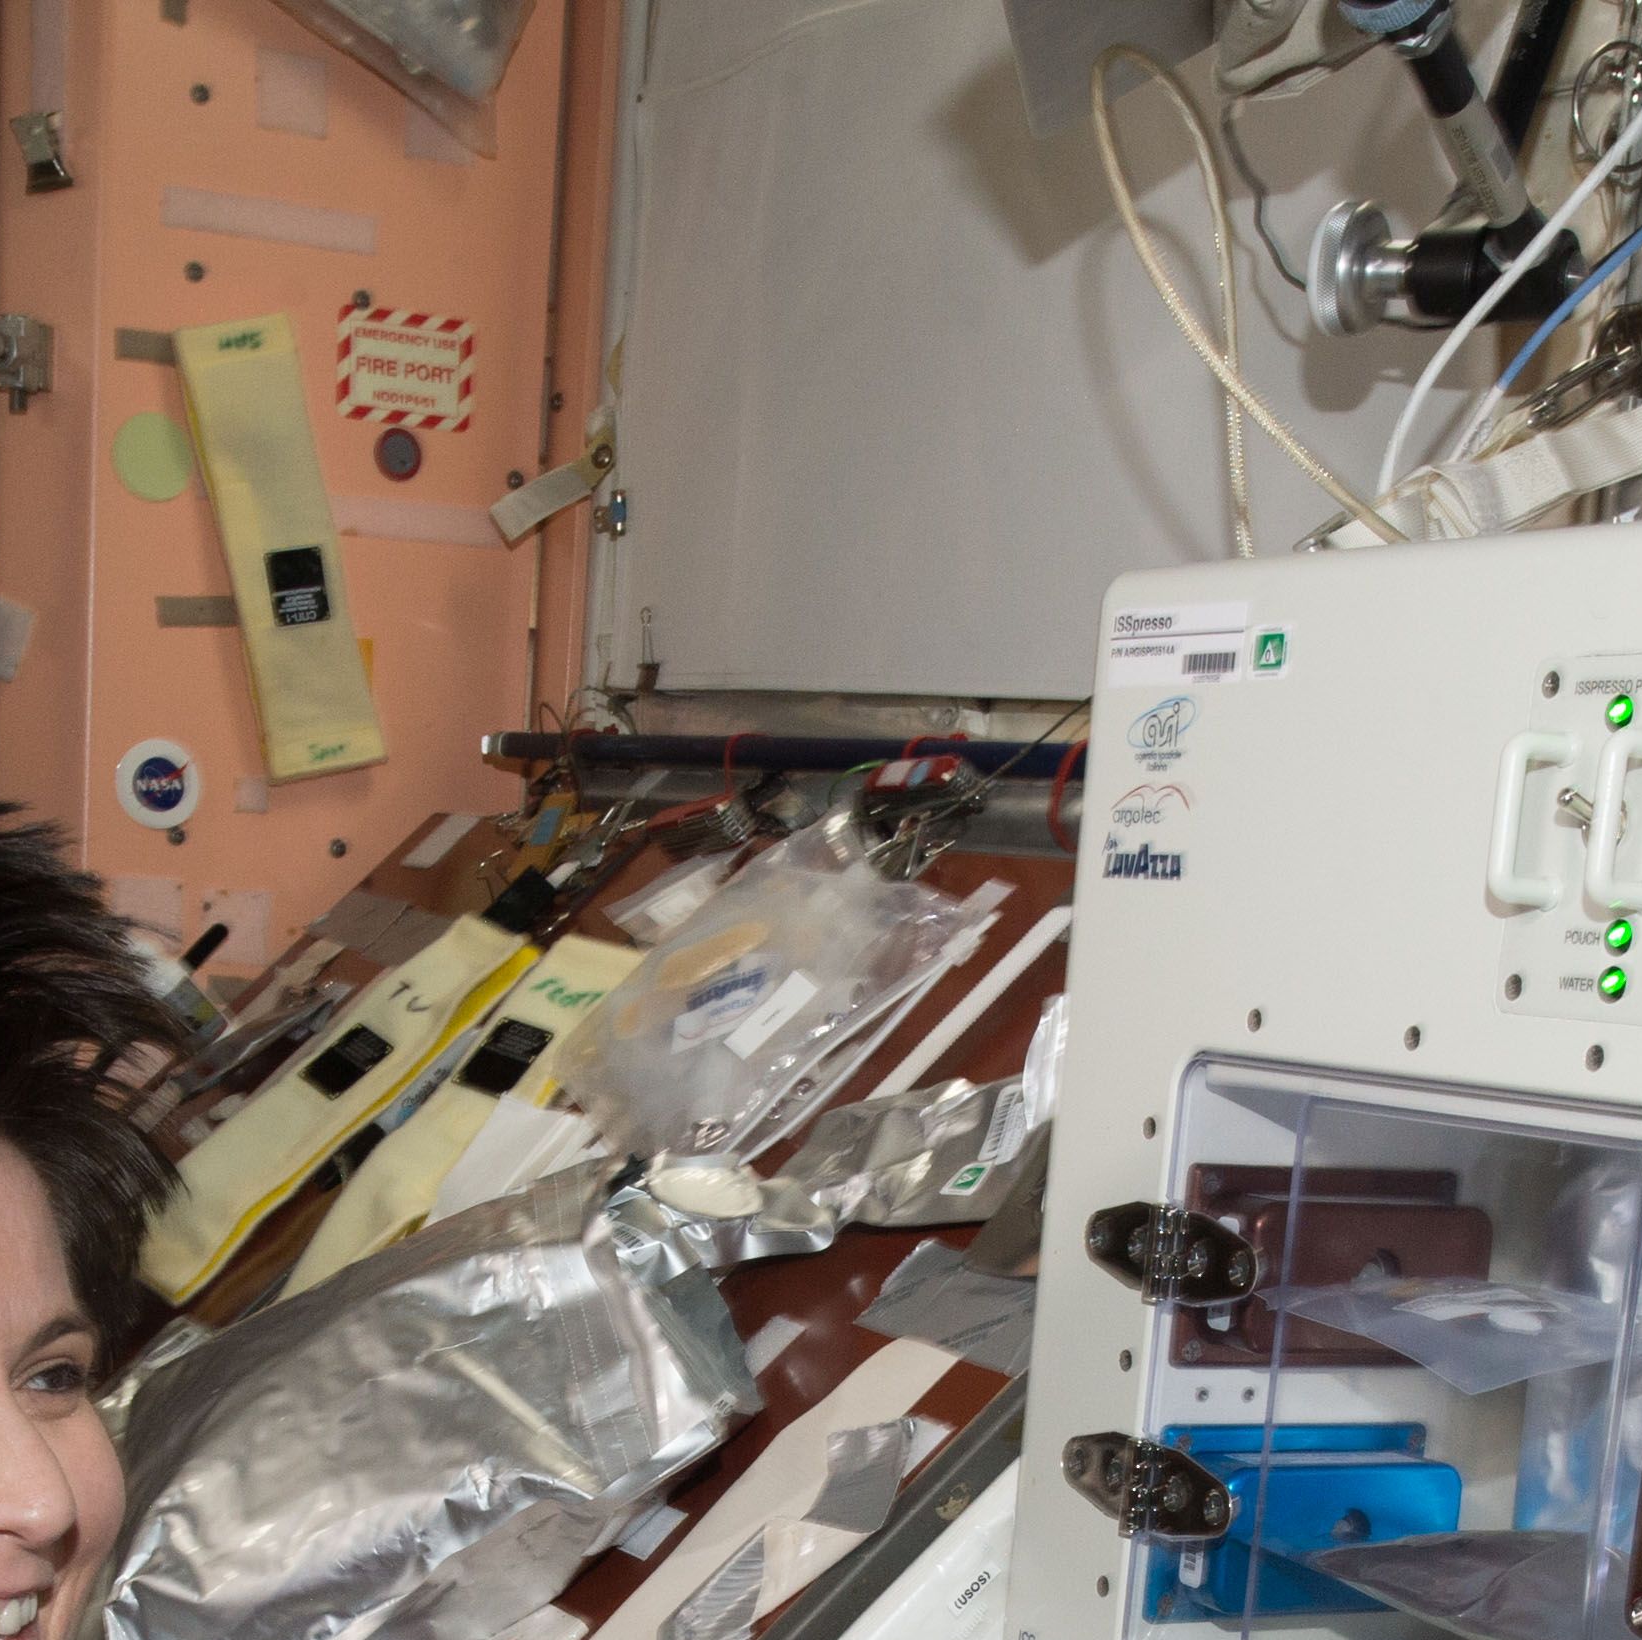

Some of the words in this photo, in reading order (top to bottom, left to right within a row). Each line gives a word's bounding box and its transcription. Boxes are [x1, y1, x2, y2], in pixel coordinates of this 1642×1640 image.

[355, 327, 431, 348] EMERGENCY
[356, 355, 399, 377] FIRE
[404, 362, 456, 384] PORT
[1113, 614, 1173, 636] ISSpresso
[1574, 680, 1634, 696] ISSPRESSO
[136, 778, 183, 792] NASA
[1112, 804, 1162, 828] argotec
[1564, 930, 1601, 946] POUCH
[1559, 976, 1594, 992] WATER
[954, 1571, 991, 1611] (USOS)
